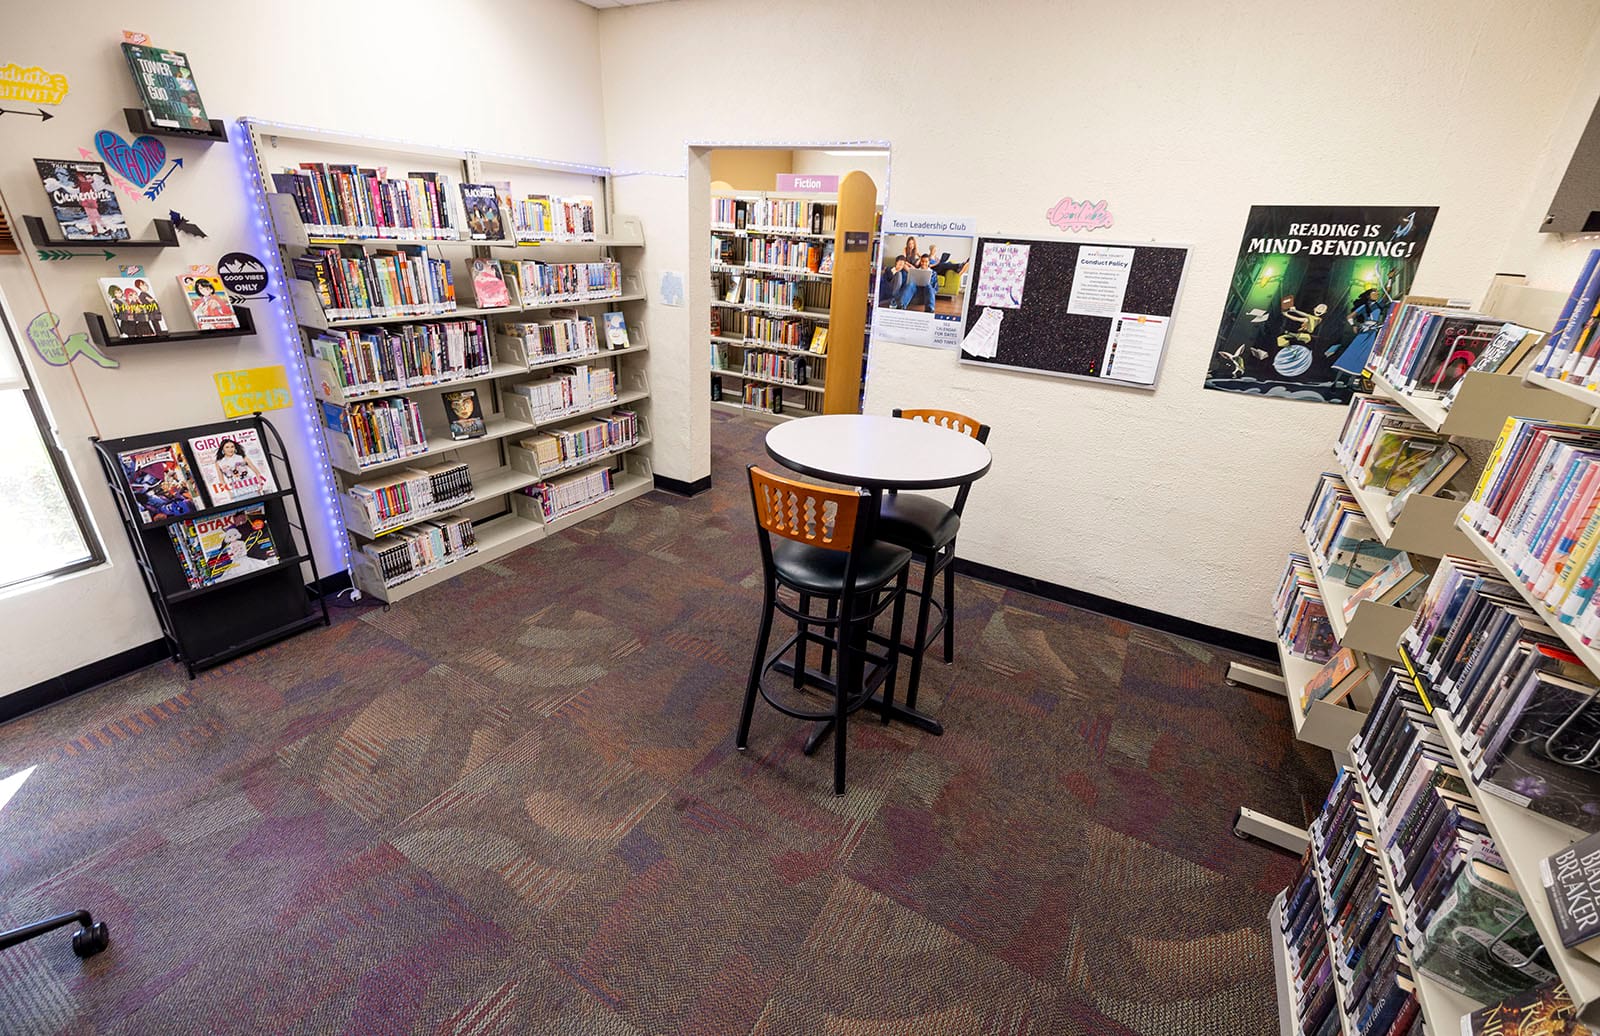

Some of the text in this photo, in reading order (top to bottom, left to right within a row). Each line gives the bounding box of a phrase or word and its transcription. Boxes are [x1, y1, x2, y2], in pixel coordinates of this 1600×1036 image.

[137, 58, 173, 76] TOWER
[143, 73, 156, 86] OF
[148, 85, 169, 101] GOD
[794, 178, 821, 188] Fiction
[53, 189, 112, 204] Clementine
[893, 220, 966, 231] Teen Leadership Club
[1289, 223, 1381, 238] READING IS
[1248, 238, 1416, 258] MIND-BENDING!
[1109, 260, 1129, 268] Policy
[235, 284, 259, 292] ONLY
[1556, 849, 1599, 931] BREAKER
